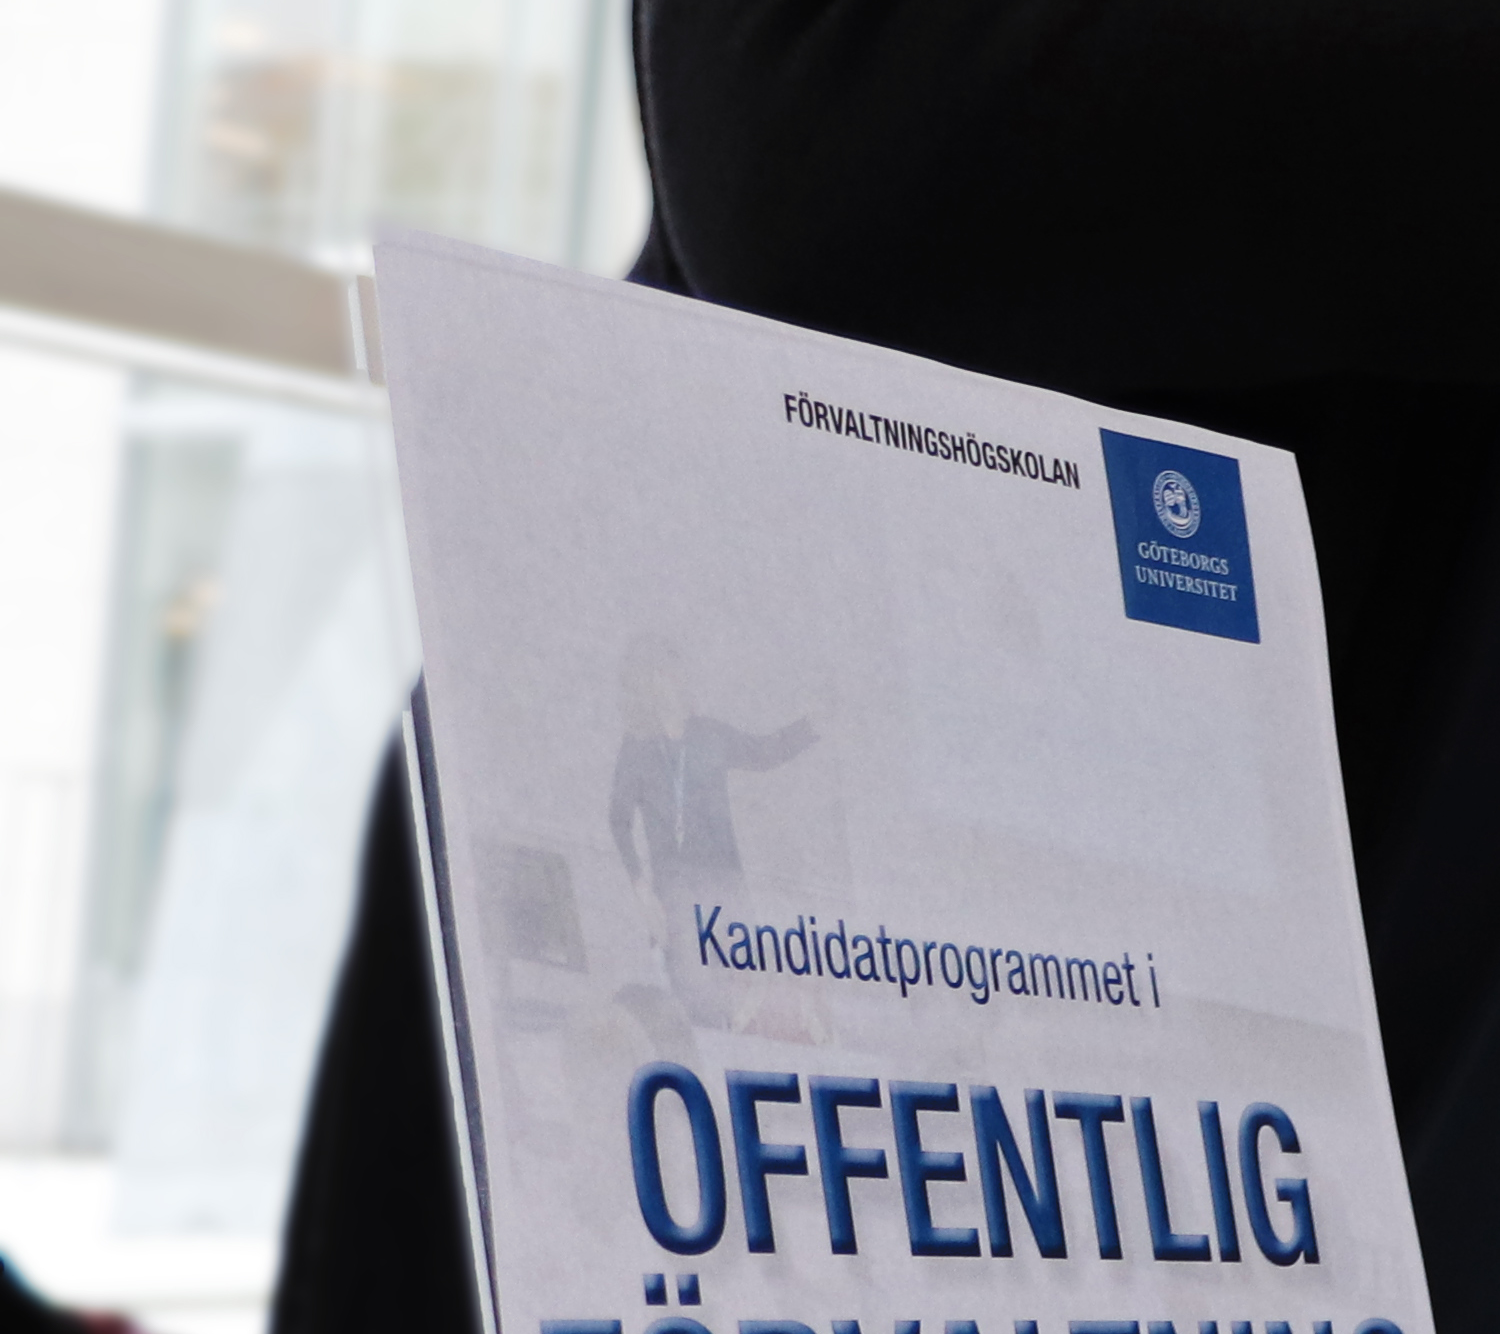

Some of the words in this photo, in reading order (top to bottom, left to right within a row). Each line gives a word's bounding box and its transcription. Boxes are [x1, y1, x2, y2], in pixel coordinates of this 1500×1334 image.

[783, 392, 1080, 490] FÖRVALTNINGSHÖGSKOLAN
[1134, 565, 1238, 602] UNIVERSITET
[1137, 540, 1229, 576] GÖTEBORGS
[693, 903, 1141, 1005] Kandidatprogrammet
[1146, 952, 1161, 1008] i
[626, 1060, 1321, 1267] OFFENTLIG
